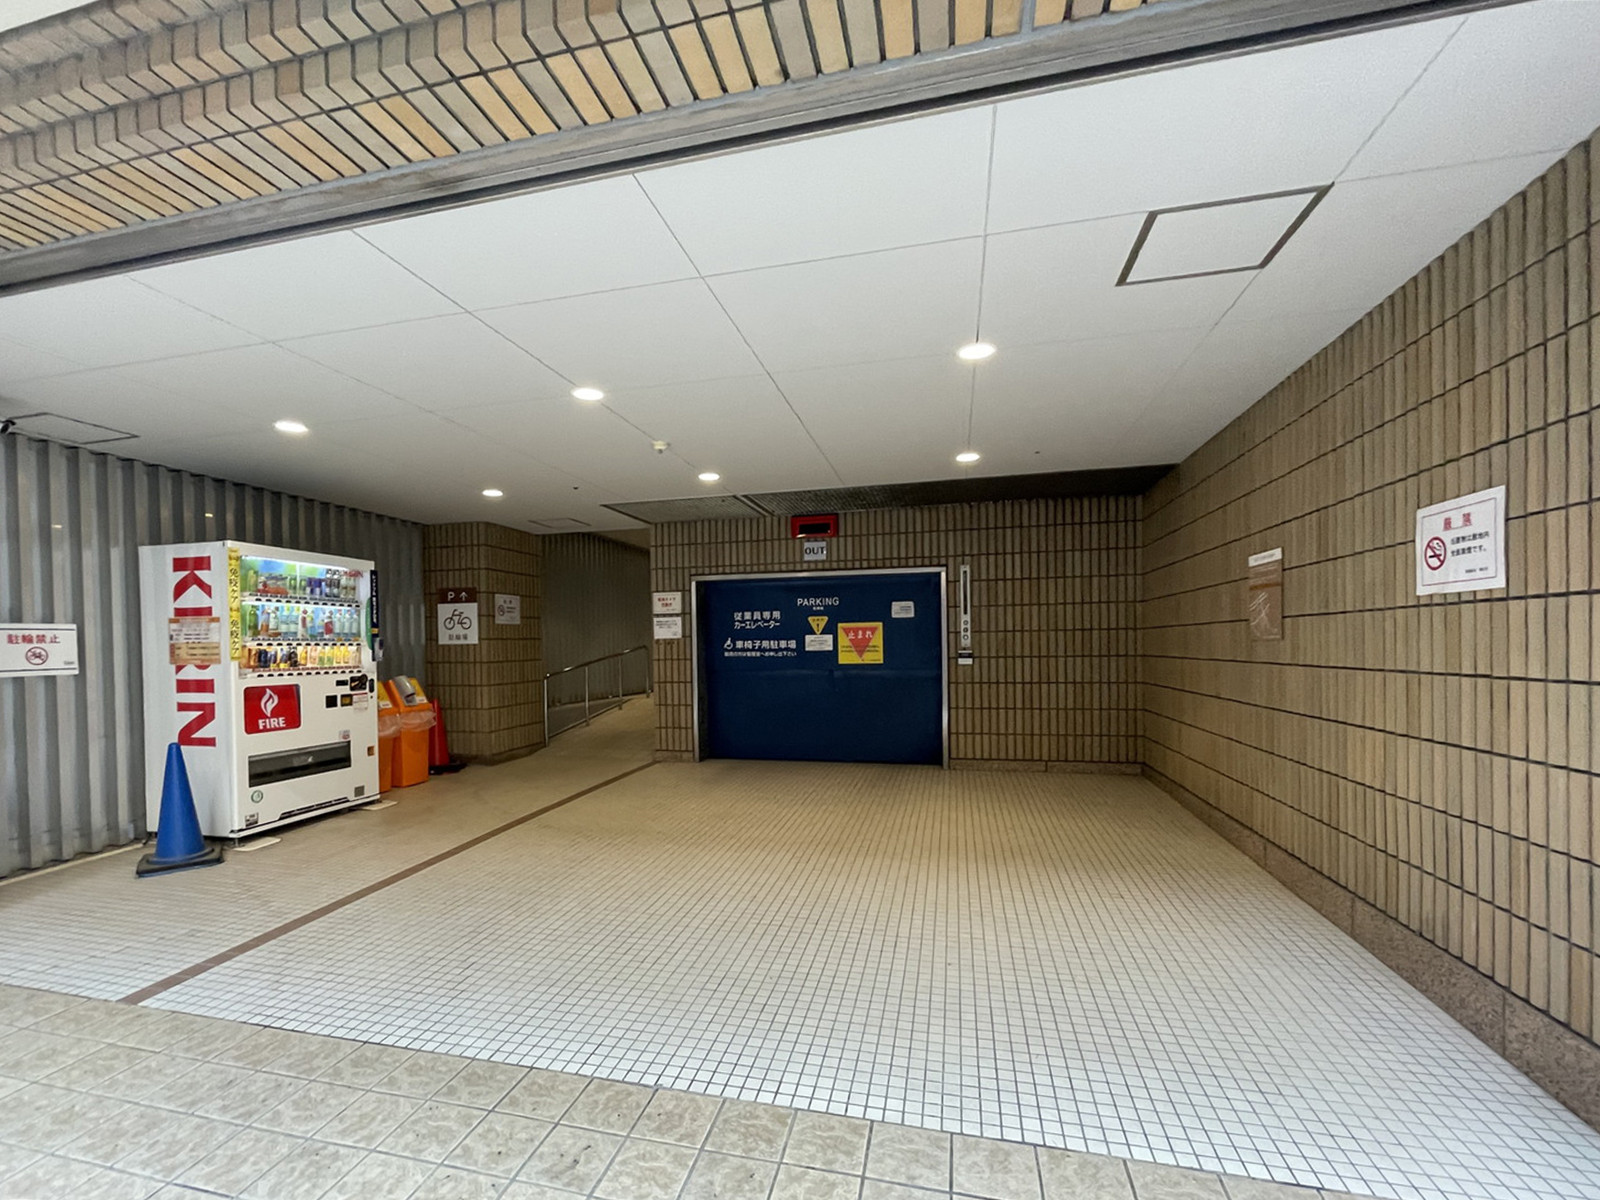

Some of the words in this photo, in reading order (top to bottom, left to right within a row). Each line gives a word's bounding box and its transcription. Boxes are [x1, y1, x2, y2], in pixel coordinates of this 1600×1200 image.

[804, 547, 826, 555] OUT
[230, 568, 239, 602] 免疫ケア
[448, 591, 455, 601] P
[797, 597, 839, 606] PARKING
[734, 610, 781, 620] 従業員専用
[734, 621, 780, 629] カーエレベーター
[7, 633, 61, 645] 駐輪禁止
[230, 619, 240, 655] 免疫ケア
[848, 630, 873, 639] 止まれ
[735, 640, 797, 649] 車椅子用駐車場
[172, 555, 216, 747] KIIN
[258, 717, 286, 730] FIRE
